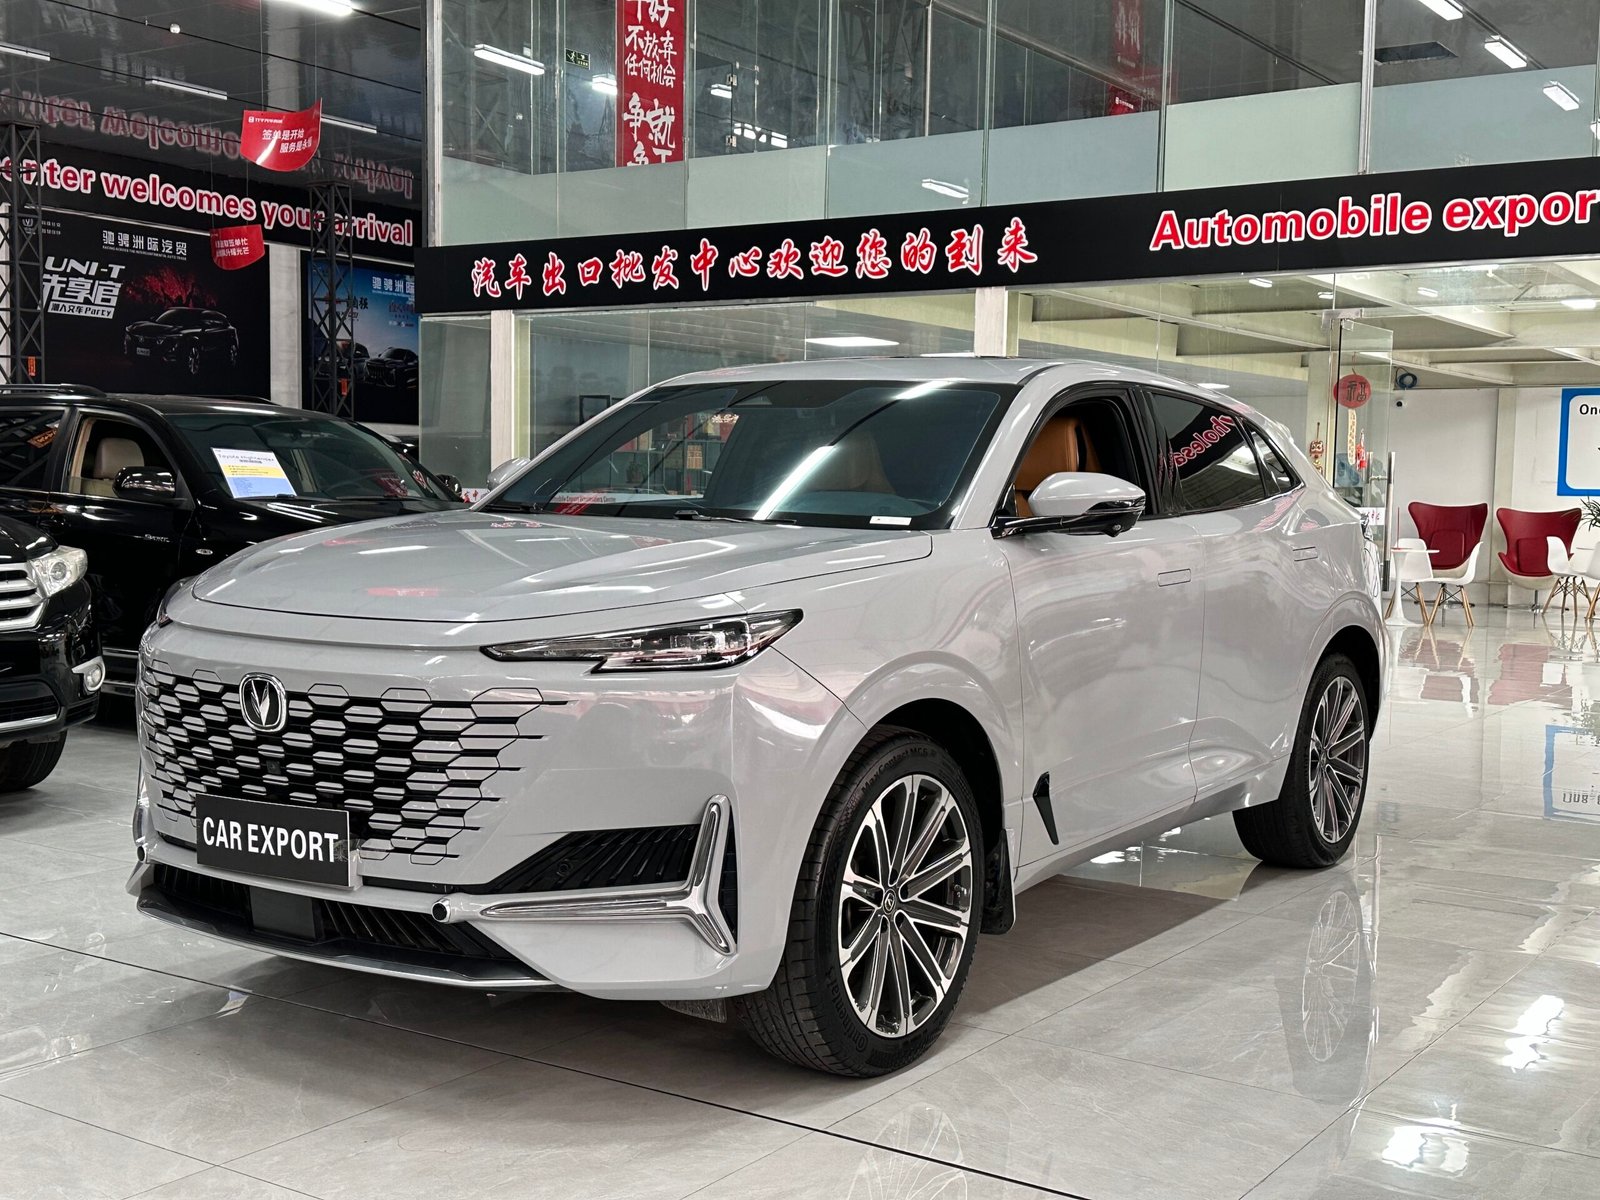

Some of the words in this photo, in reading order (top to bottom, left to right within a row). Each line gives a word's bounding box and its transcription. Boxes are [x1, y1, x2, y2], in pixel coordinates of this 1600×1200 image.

[625, 25, 677, 62] 不放弃
[625, 53, 676, 88] 任何机会
[622, 92, 676, 148] 争就
[100, 171, 257, 221] welcomes
[260, 200, 325, 231] your
[333, 211, 413, 247] arrival
[1149, 191, 1432, 251] Automobile
[44, 256, 126, 279] UNI-T
[471, 216, 1039, 300] 汽车出口批发中心欢迎您的到来
[84, 305, 113, 318] Party
[1579, 403, 1600, 416] On
[202, 816, 243, 851] CAR
[247, 824, 339, 863] EXPORT
